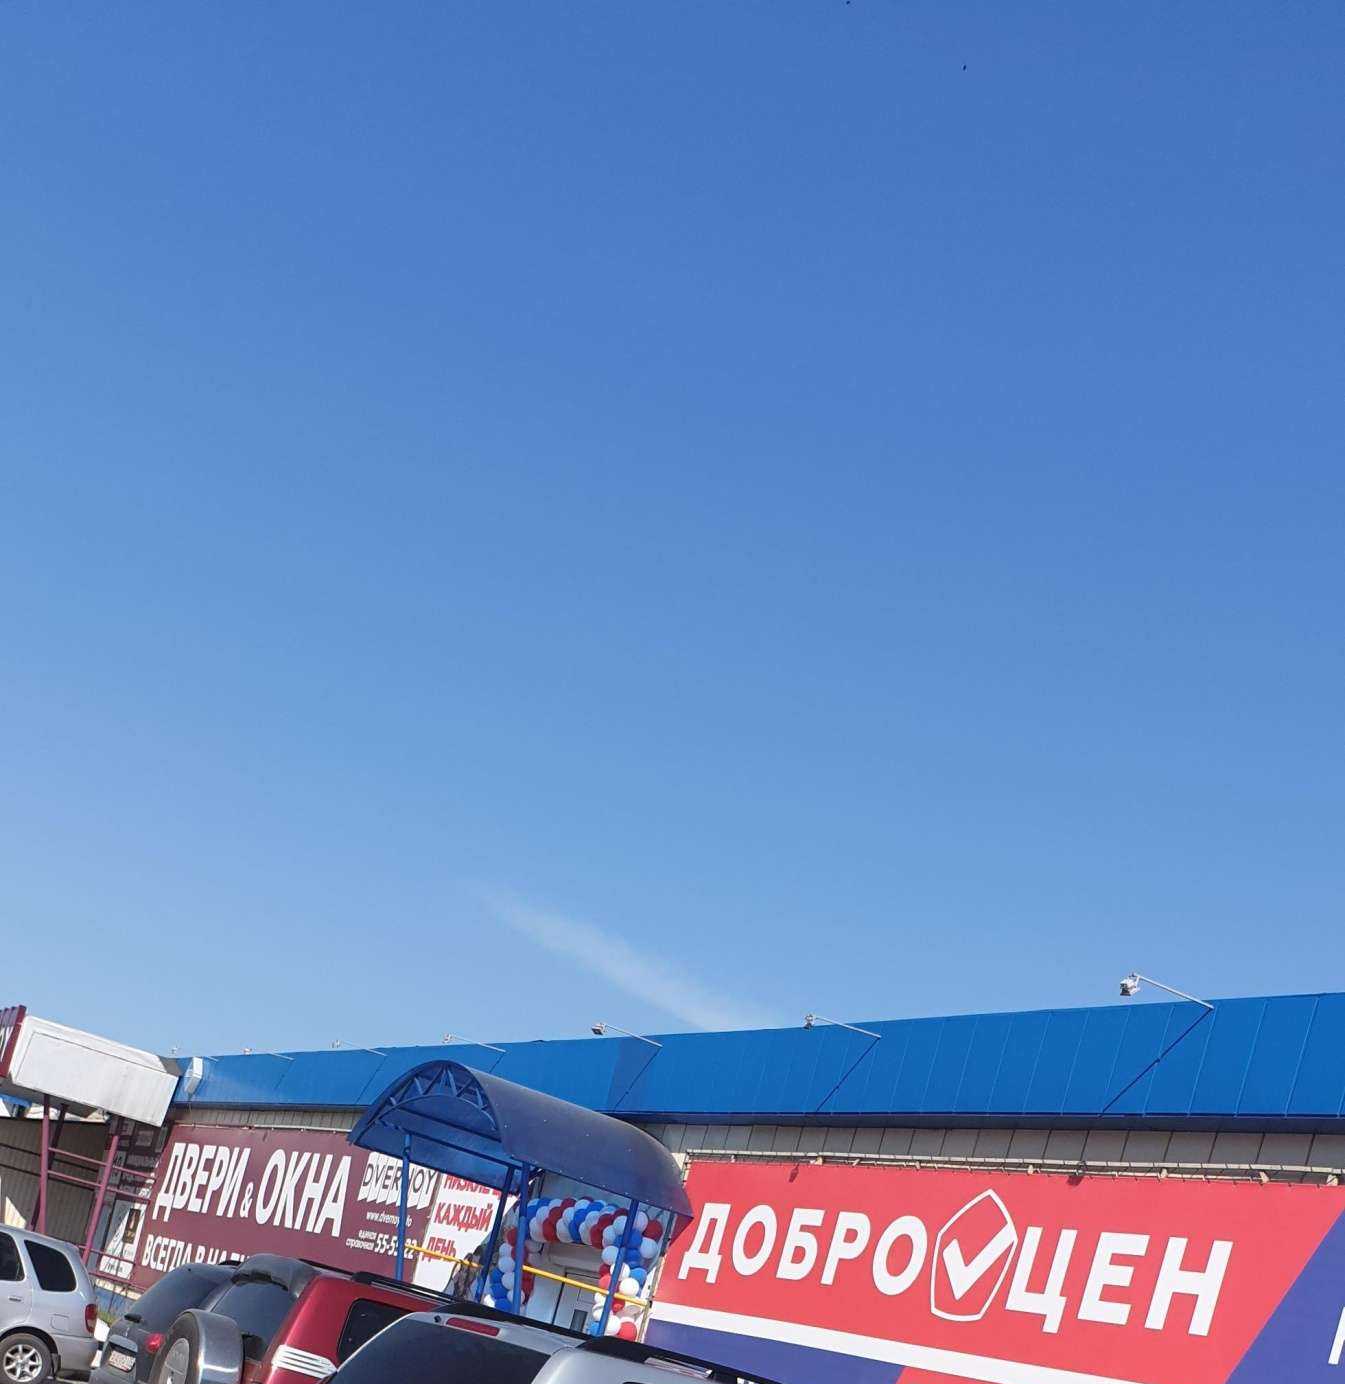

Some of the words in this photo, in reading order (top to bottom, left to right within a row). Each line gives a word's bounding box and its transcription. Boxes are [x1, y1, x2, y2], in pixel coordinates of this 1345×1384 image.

[152, 1142, 251, 1222] ДВЕРИ
[239, 1181, 254, 1218] &
[255, 1149, 352, 1238] ОКНА
[362, 1162, 437, 1196] DVEROY
[434, 1201, 494, 1232] КАЖДЫЙ
[141, 1234, 193, 1273] ВСЕГДА
